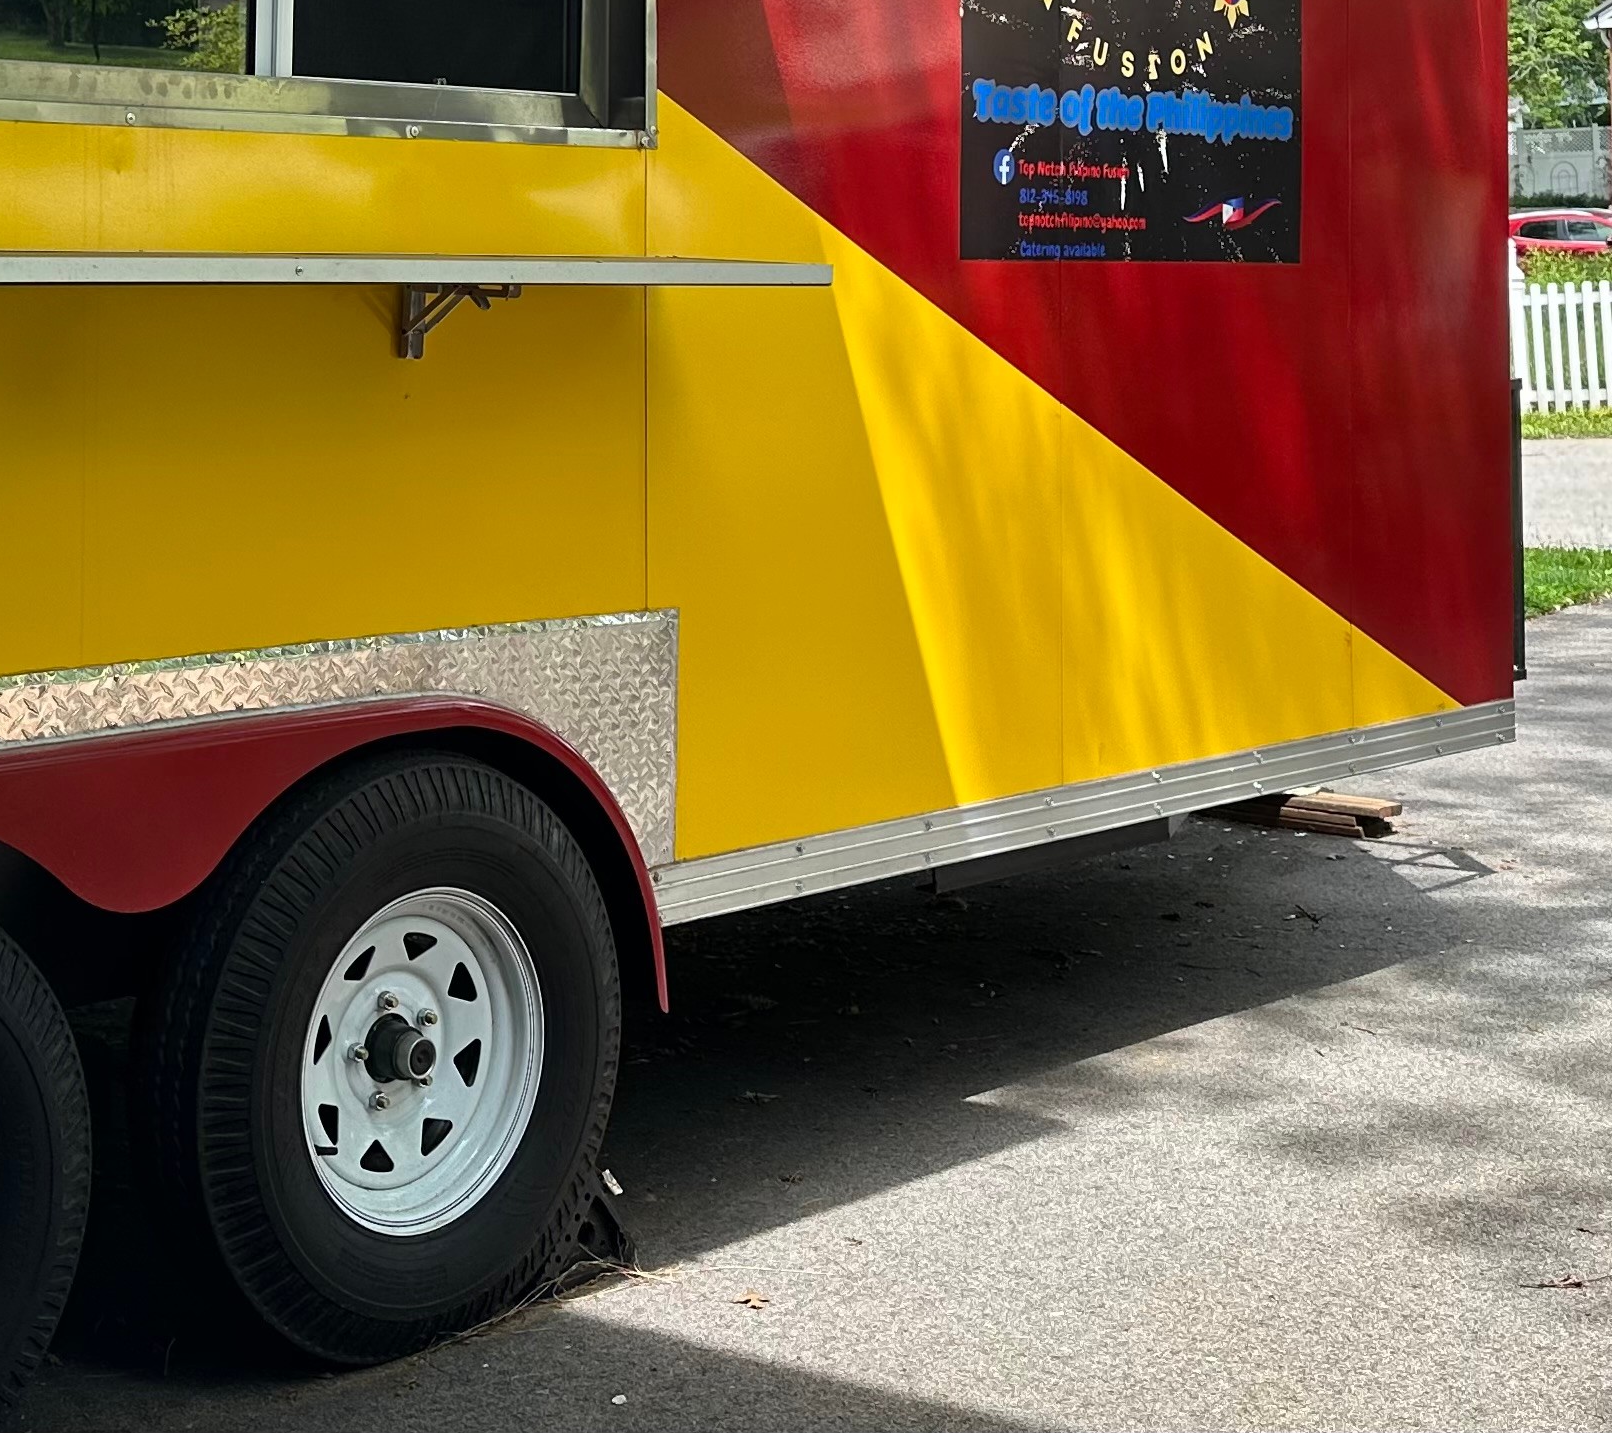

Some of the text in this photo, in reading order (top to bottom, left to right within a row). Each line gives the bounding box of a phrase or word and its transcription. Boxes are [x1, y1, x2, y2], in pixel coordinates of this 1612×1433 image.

[1066, 19, 1214, 80] FUSION
[974, 79, 1293, 144] Taste of the Philippines
[1018, 159, 1036, 180] Top
[1037, 161, 1066, 177] Notch
[1103, 163, 1131, 179] Fusion
[1019, 187, 1089, 206] 812-345-8198
[1020, 239, 1106, 261] Catering available
